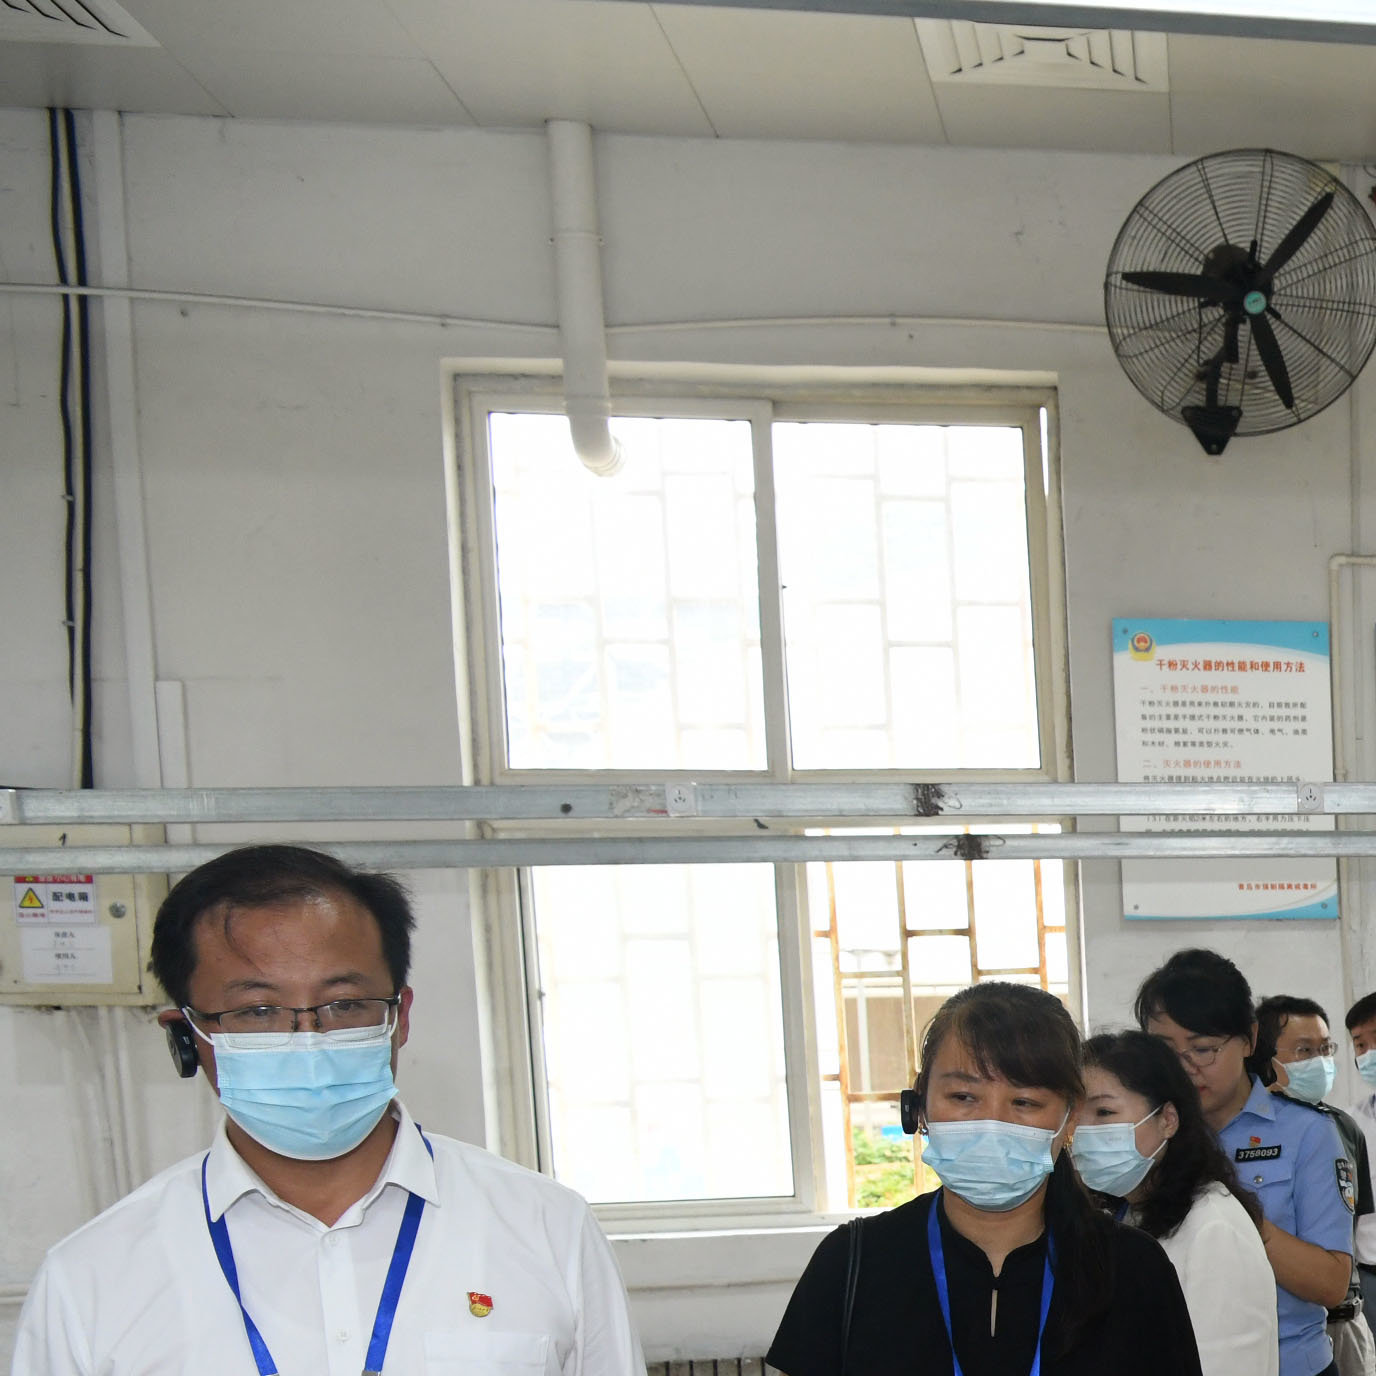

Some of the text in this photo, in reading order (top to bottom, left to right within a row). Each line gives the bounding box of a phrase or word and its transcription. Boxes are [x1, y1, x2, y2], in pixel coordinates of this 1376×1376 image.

[1155, 658, 1306, 673] 干粉灭火器的性能和使用方法
[52, 891, 90, 903] 配电箱
[1237, 1147, 1280, 1161] 3758093
